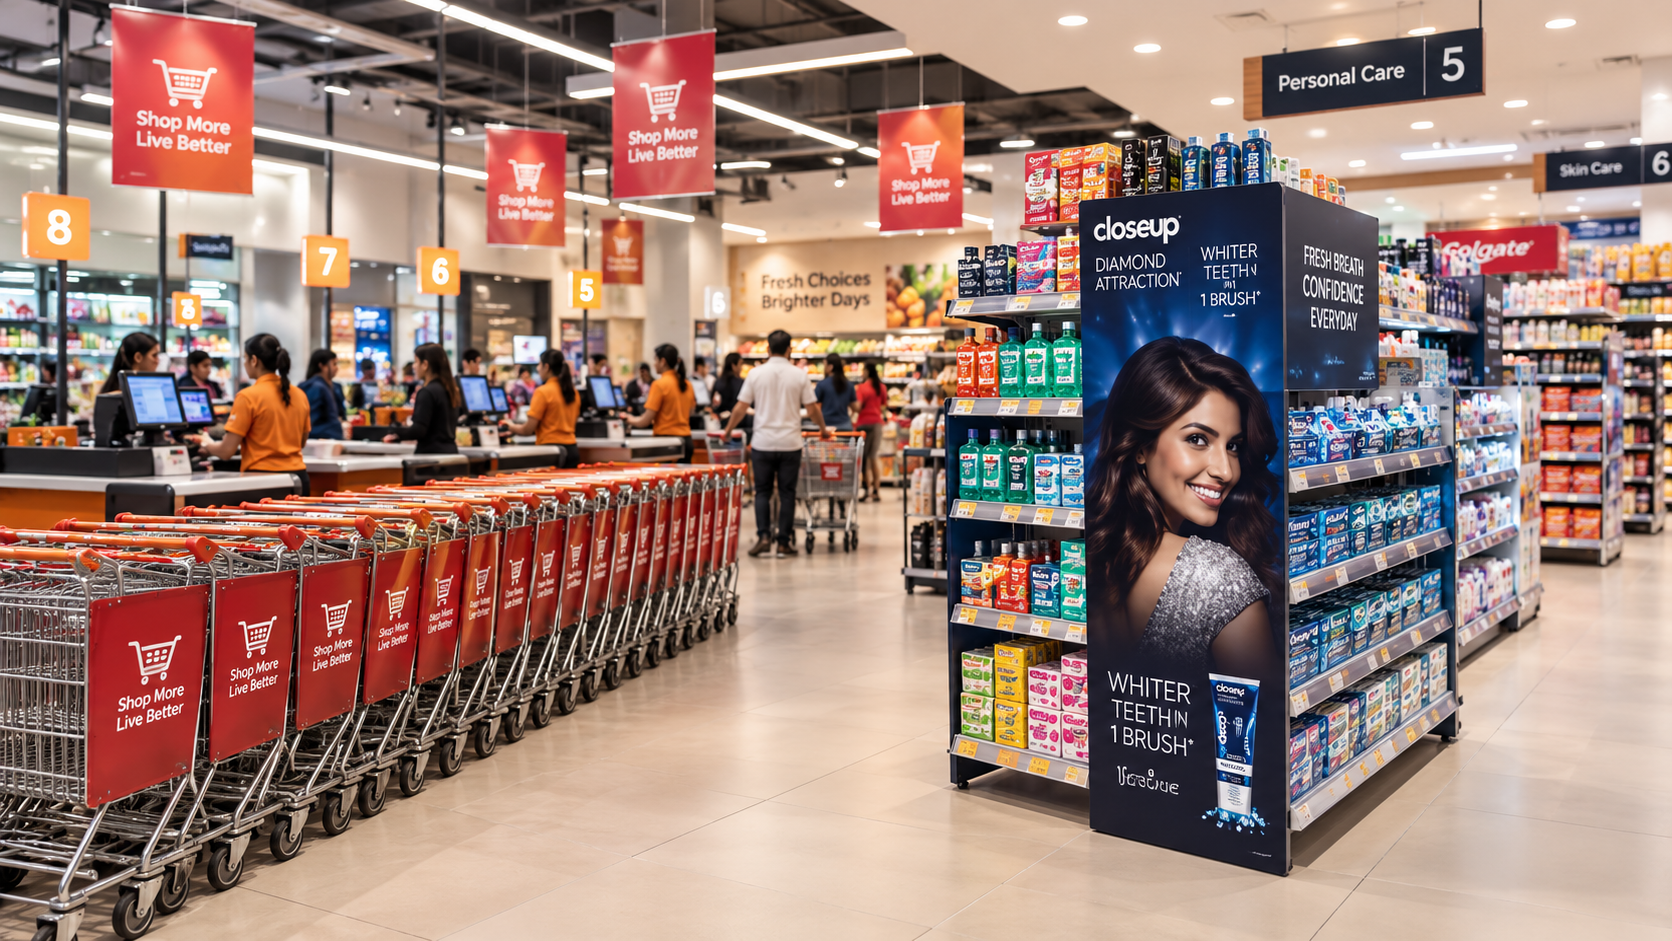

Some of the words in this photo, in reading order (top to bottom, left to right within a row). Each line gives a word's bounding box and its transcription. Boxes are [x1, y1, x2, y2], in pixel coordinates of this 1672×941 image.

[1441, 45, 1465, 83] 5
[1278, 66, 1356, 92] Personal
[1360, 64, 1406, 83] Care
[136, 109, 183, 133] Shop
[186, 114, 231, 136] More
[136, 130, 173, 150] Live
[177, 133, 232, 155] Better
[628, 129, 662, 147] Shop
[664, 126, 698, 142] More
[628, 147, 655, 164] Live
[656, 144, 698, 161] Better
[1652, 150, 1671, 176] 6
[1559, 162, 1590, 178] Skin
[1590, 160, 1623, 175] Care
[891, 178, 921, 194] Shop
[921, 176, 950, 190] More
[498, 193, 527, 209] Shop
[891, 192, 915, 206] Live
[915, 190, 951, 205] Better
[498, 206, 521, 220] Live
[521, 208, 555, 222] Better
[46, 209, 73, 245] 8
[1093, 215, 1181, 245] closeup
[318, 246, 338, 276] 7
[1095, 253, 1166, 273] DIAMOND
[1200, 242, 1258, 261] WHITER
[1303, 245, 1333, 271] FRESH
[1333, 252, 1364, 278] BREATH
[1442, 240, 1534, 265] Colgate
[431, 257, 450, 286] 6
[761, 274, 804, 289] Fresh
[807, 271, 872, 289] Choices
[1095, 271, 1182, 291] ATTRACTION
[1203, 263, 1249, 280] TEETH
[579, 278, 595, 302] 5
[761, 293, 827, 312] Brighter
[831, 291, 871, 310] Days
[1200, 293, 1206, 307] 1
[1302, 274, 1365, 305] CONFIDENCE
[1310, 306, 1358, 332] EVERYDAY
[313, 645, 334, 658] Shop
[334, 638, 354, 652] More
[229, 667, 254, 682] Shop
[255, 659, 279, 675] More
[228, 684, 249, 699] Live
[250, 674, 279, 692] Better
[1106, 670, 1192, 706] WHITER
[117, 694, 152, 713] Shop
[153, 685, 185, 704] More
[116, 714, 144, 733] Live
[146, 702, 185, 724] Better
[1111, 698, 1171, 728] TEETH
[1110, 724, 1117, 744] 1
